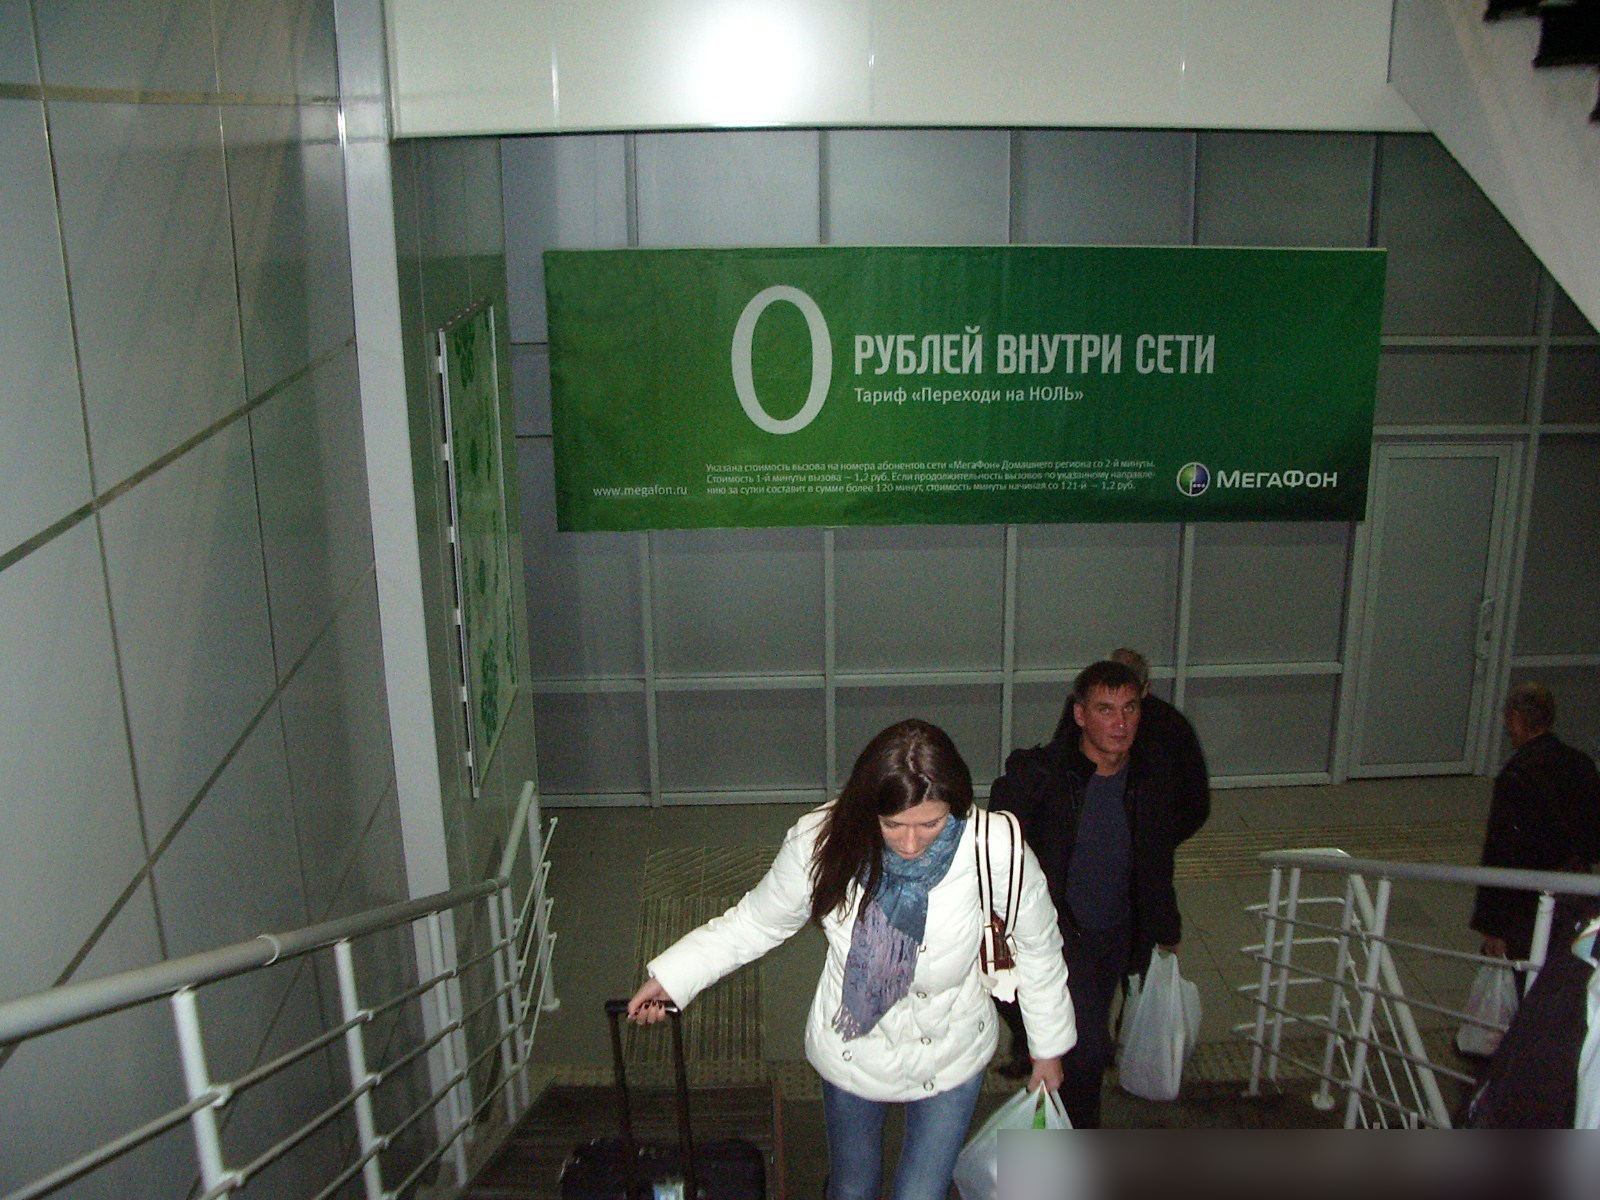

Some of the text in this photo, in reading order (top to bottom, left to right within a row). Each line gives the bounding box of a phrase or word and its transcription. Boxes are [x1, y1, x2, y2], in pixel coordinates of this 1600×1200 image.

[854, 326, 983, 375] РУБЛЕЙ
[997, 334, 1122, 374] ВНУТРИ
[1136, 333, 1216, 374] СЕТИ
[854, 386, 1084, 405] Тариф «Переходи на НОЛЬ»
[706, 464, 742, 472] Указана
[744, 464, 790, 472] стоимость
[792, 463, 826, 471] вызова
[840, 463, 875, 472] номера
[877, 461, 925, 470] абонентов
[926, 462, 947, 470] сети
[948, 460, 1000, 470] «МегаФон»
[1001, 460, 1053, 470] Домашнего
[1055, 461, 1091, 470] региона
[1104, 459, 1119, 468] 2-й
[707, 475, 754, 483] Стоимость
[757, 474, 770, 482] 1-й
[772, 475, 806, 483] минуты
[808, 474, 842, 482] вызова
[854, 473, 869, 482] 1,2
[871, 472, 890, 483] руб.
[892, 472, 913, 481] Если
[914, 472, 1003, 482] продолжительность
[1057, 471, 1110, 480] указанному
[593, 485, 687, 497] www.megafon.ru
[740, 486, 764, 495] сутки
[815, 485, 844, 494] сумме
[846, 483, 874, 492] более
[876, 484, 894, 492] 120
[895, 484, 924, 493] минут,
[926, 484, 972, 492] стоимость
[973, 483, 1007, 492] минуты
[1047, 482, 1059, 490] со
[1061, 481, 1087, 490] 121-й
[1102, 481, 1116, 490] 1,2
[1117, 480, 1136, 491] руб.
